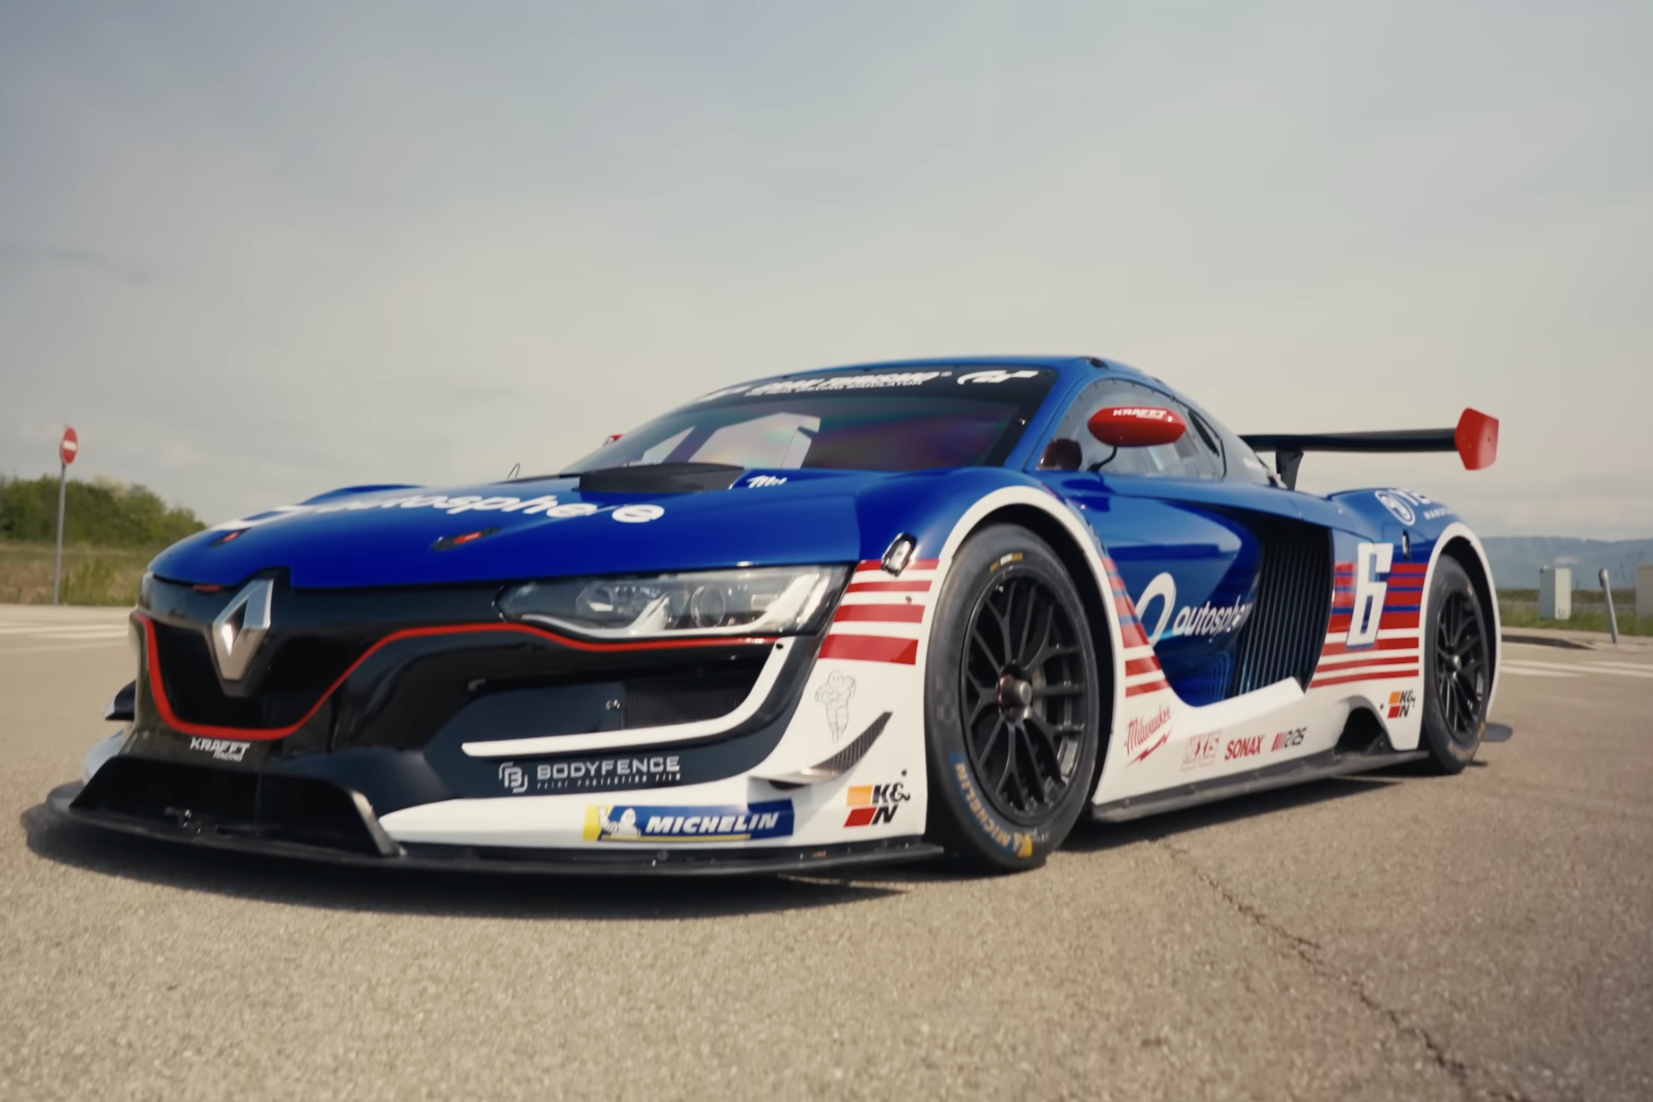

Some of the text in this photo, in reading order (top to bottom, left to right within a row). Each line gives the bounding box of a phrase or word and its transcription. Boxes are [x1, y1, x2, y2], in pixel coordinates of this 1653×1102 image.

[1346, 542, 1394, 650] 6
[1126, 705, 1171, 755] Milwaukee
[190, 737, 251, 758] KRAFFT
[1224, 735, 1264, 761] SONAX
[537, 756, 680, 780] BODYFENCE
[955, 763, 1012, 848] MICHELIN
[645, 812, 779, 833] MICHELIN
